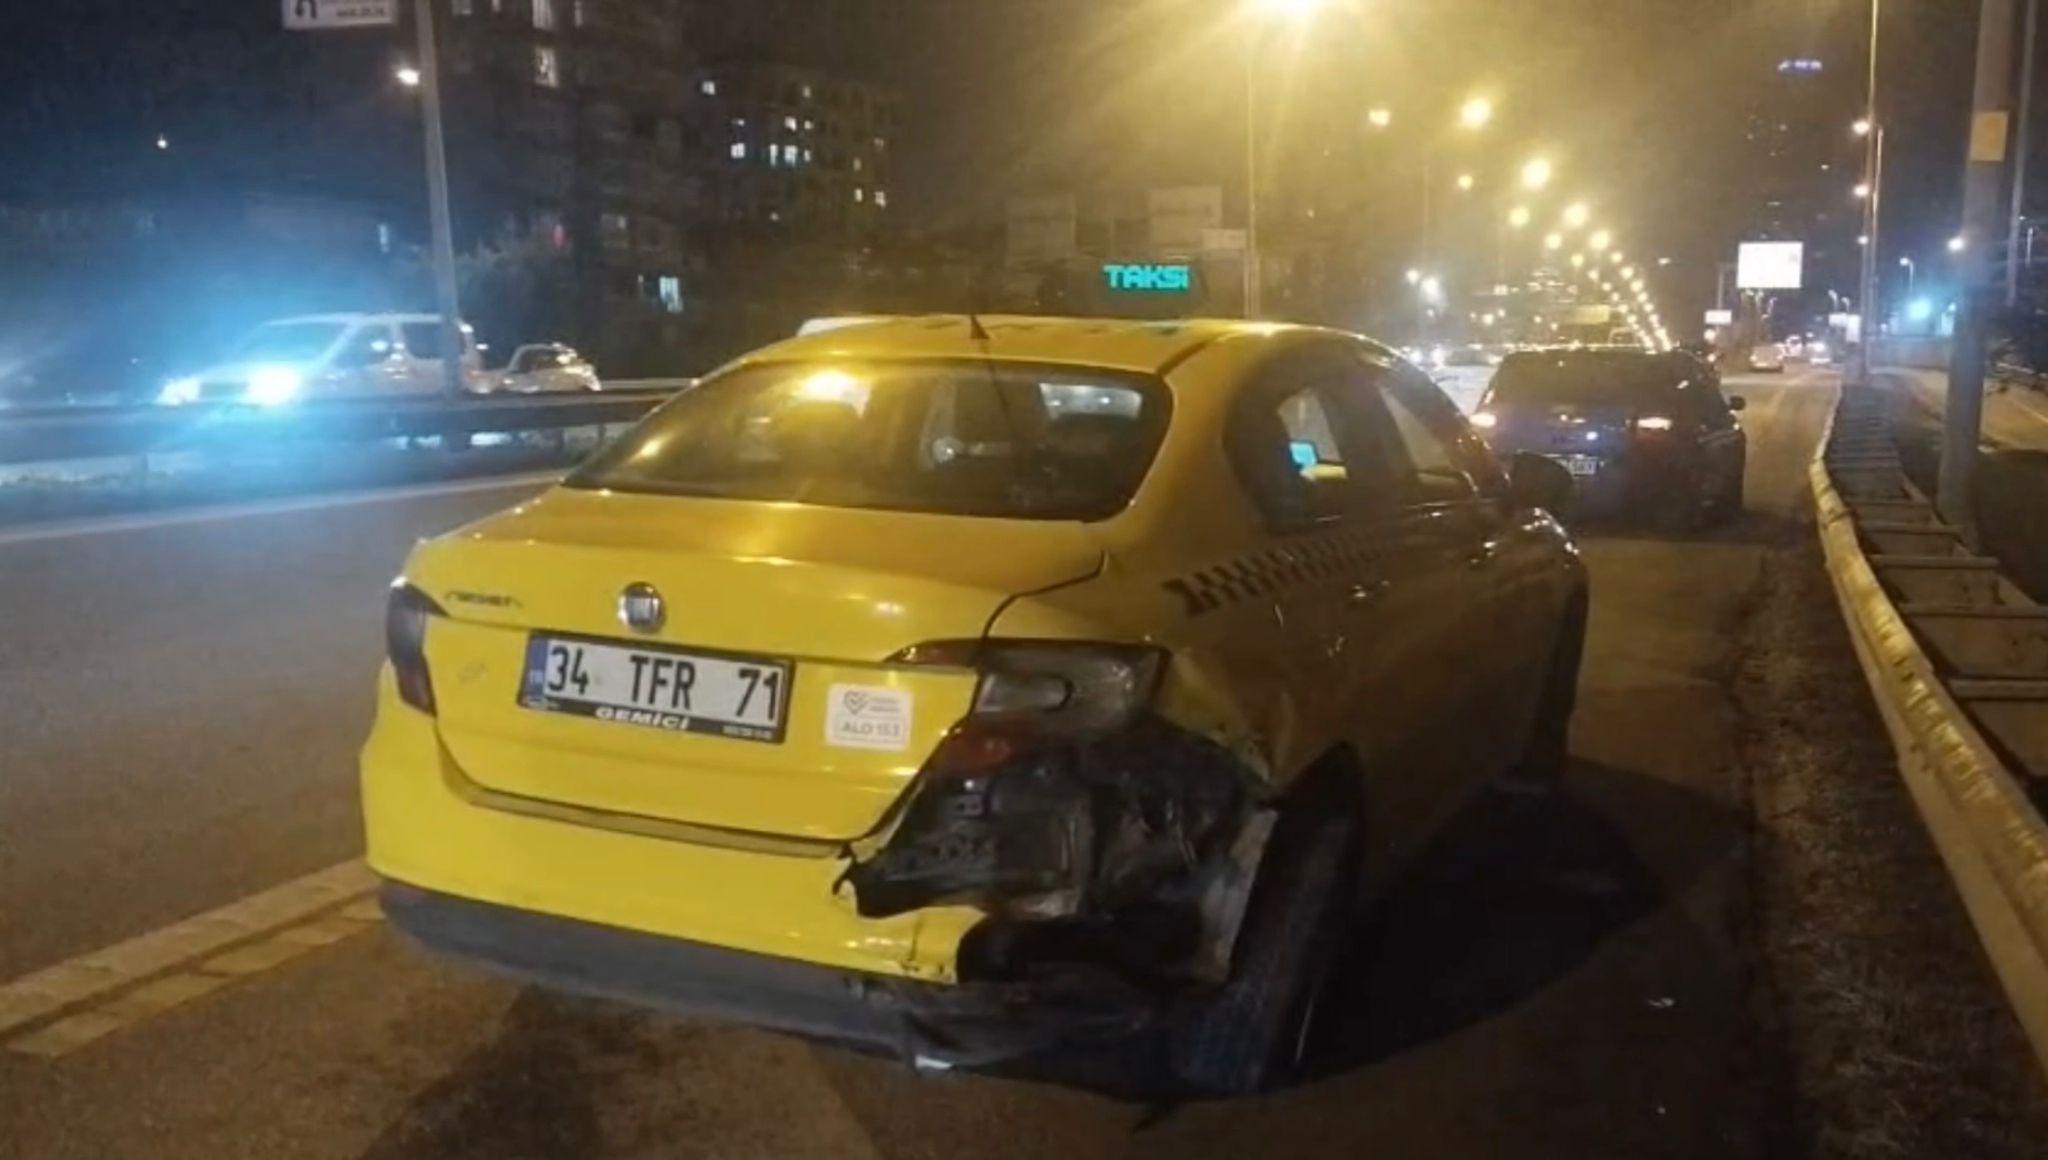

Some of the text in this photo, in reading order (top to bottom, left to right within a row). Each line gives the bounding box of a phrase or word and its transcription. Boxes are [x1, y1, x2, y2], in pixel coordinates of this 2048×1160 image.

[547, 646, 780, 721] 34 TFR 71
